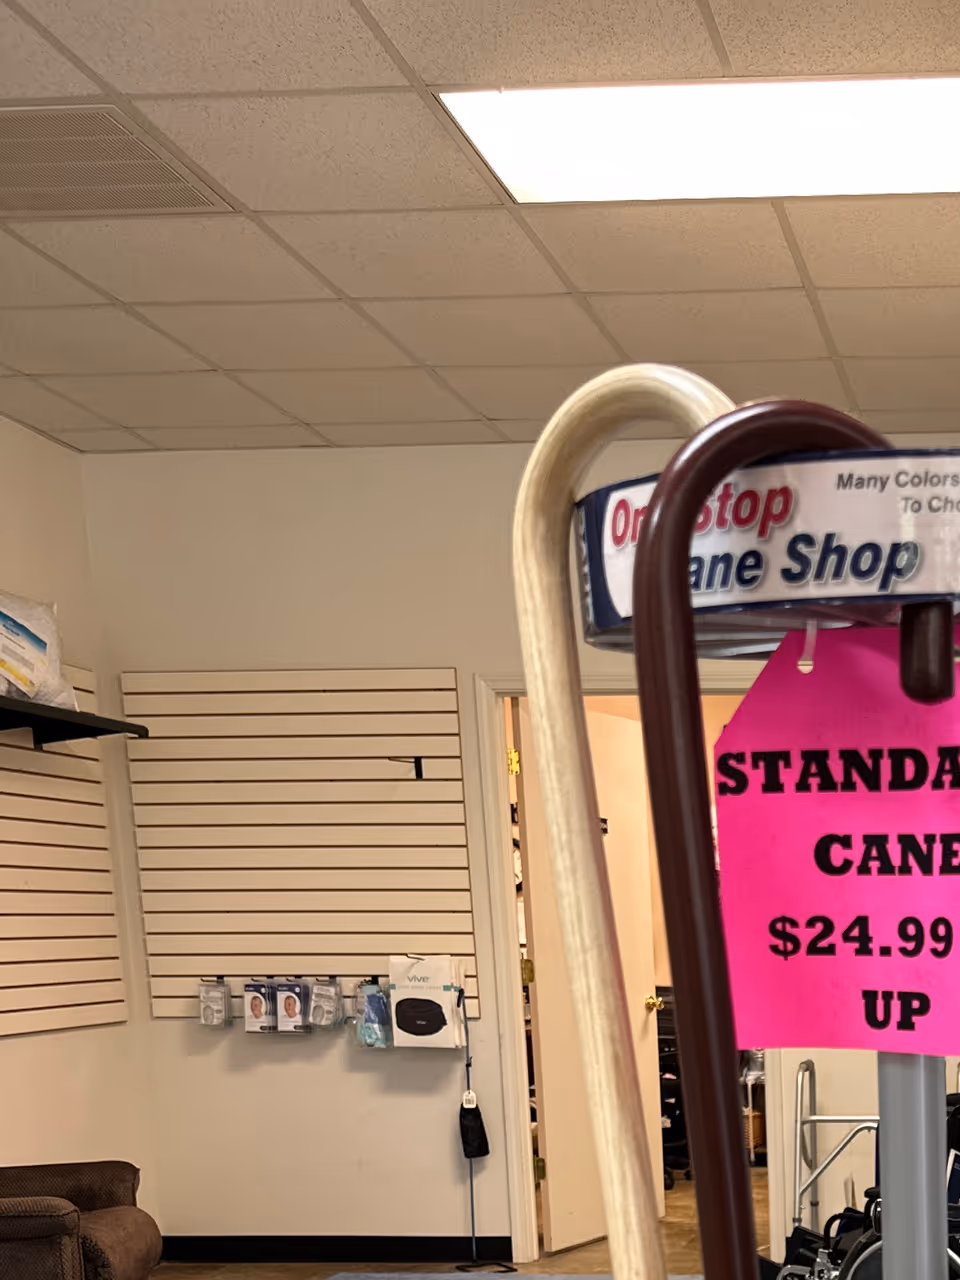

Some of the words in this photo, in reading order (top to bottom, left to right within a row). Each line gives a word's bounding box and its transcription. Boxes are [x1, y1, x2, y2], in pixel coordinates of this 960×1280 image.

[836, 473, 892, 493] Many
[894, 470, 960, 490] Colors
[901, 496, 922, 514] To
[689, 548, 765, 593] ane
[780, 532, 920, 593] Shop
[768, 914, 954, 961] $24.99
[408, 974, 430, 983] vive
[860, 988, 932, 1032] UP
